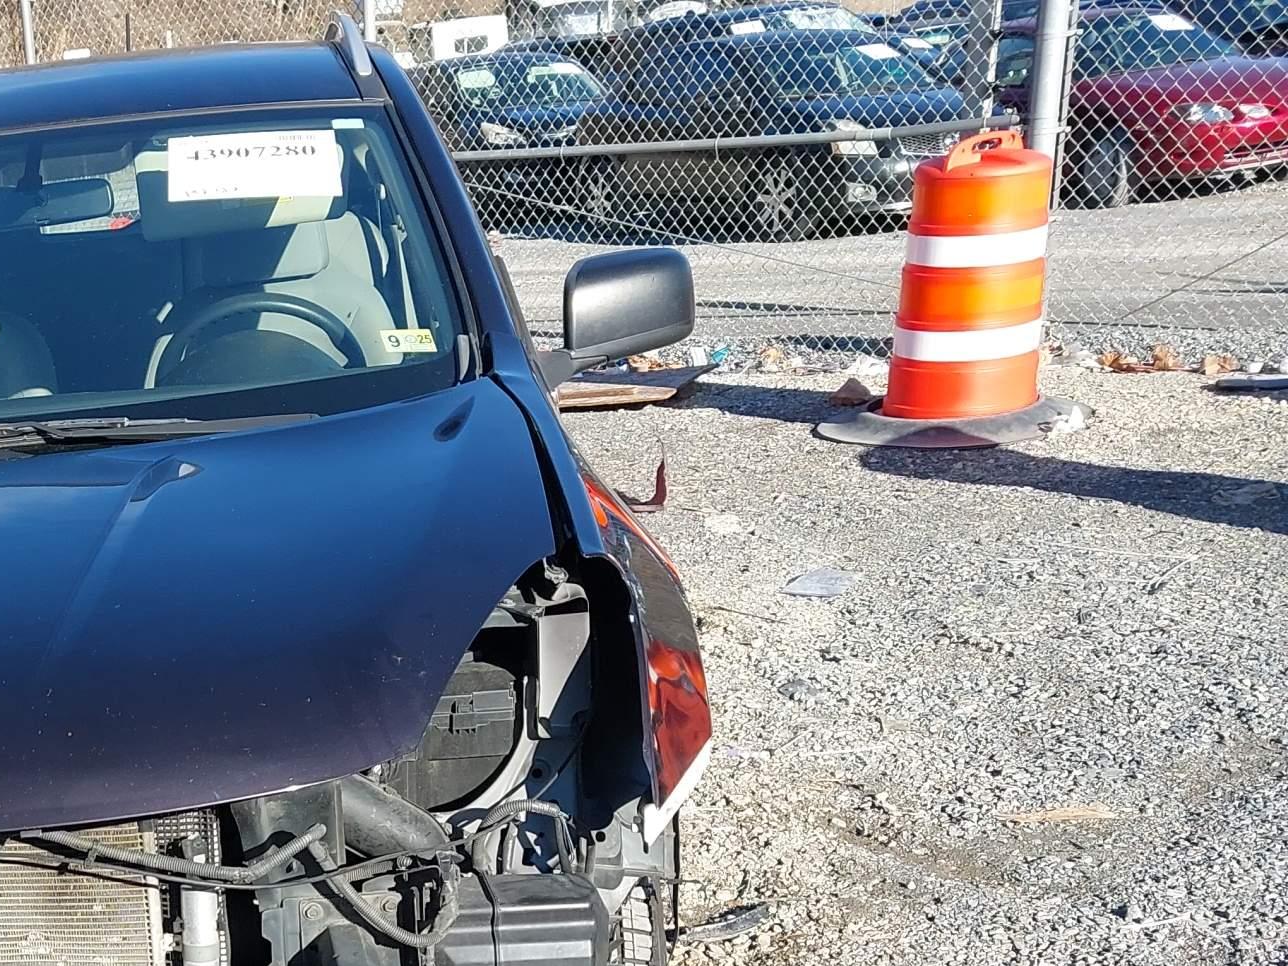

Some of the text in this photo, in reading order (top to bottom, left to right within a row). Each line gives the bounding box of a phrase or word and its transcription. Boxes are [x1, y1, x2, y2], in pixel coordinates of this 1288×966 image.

[187, 145, 316, 161] 43907280
[387, 334, 432, 348] 9 25
